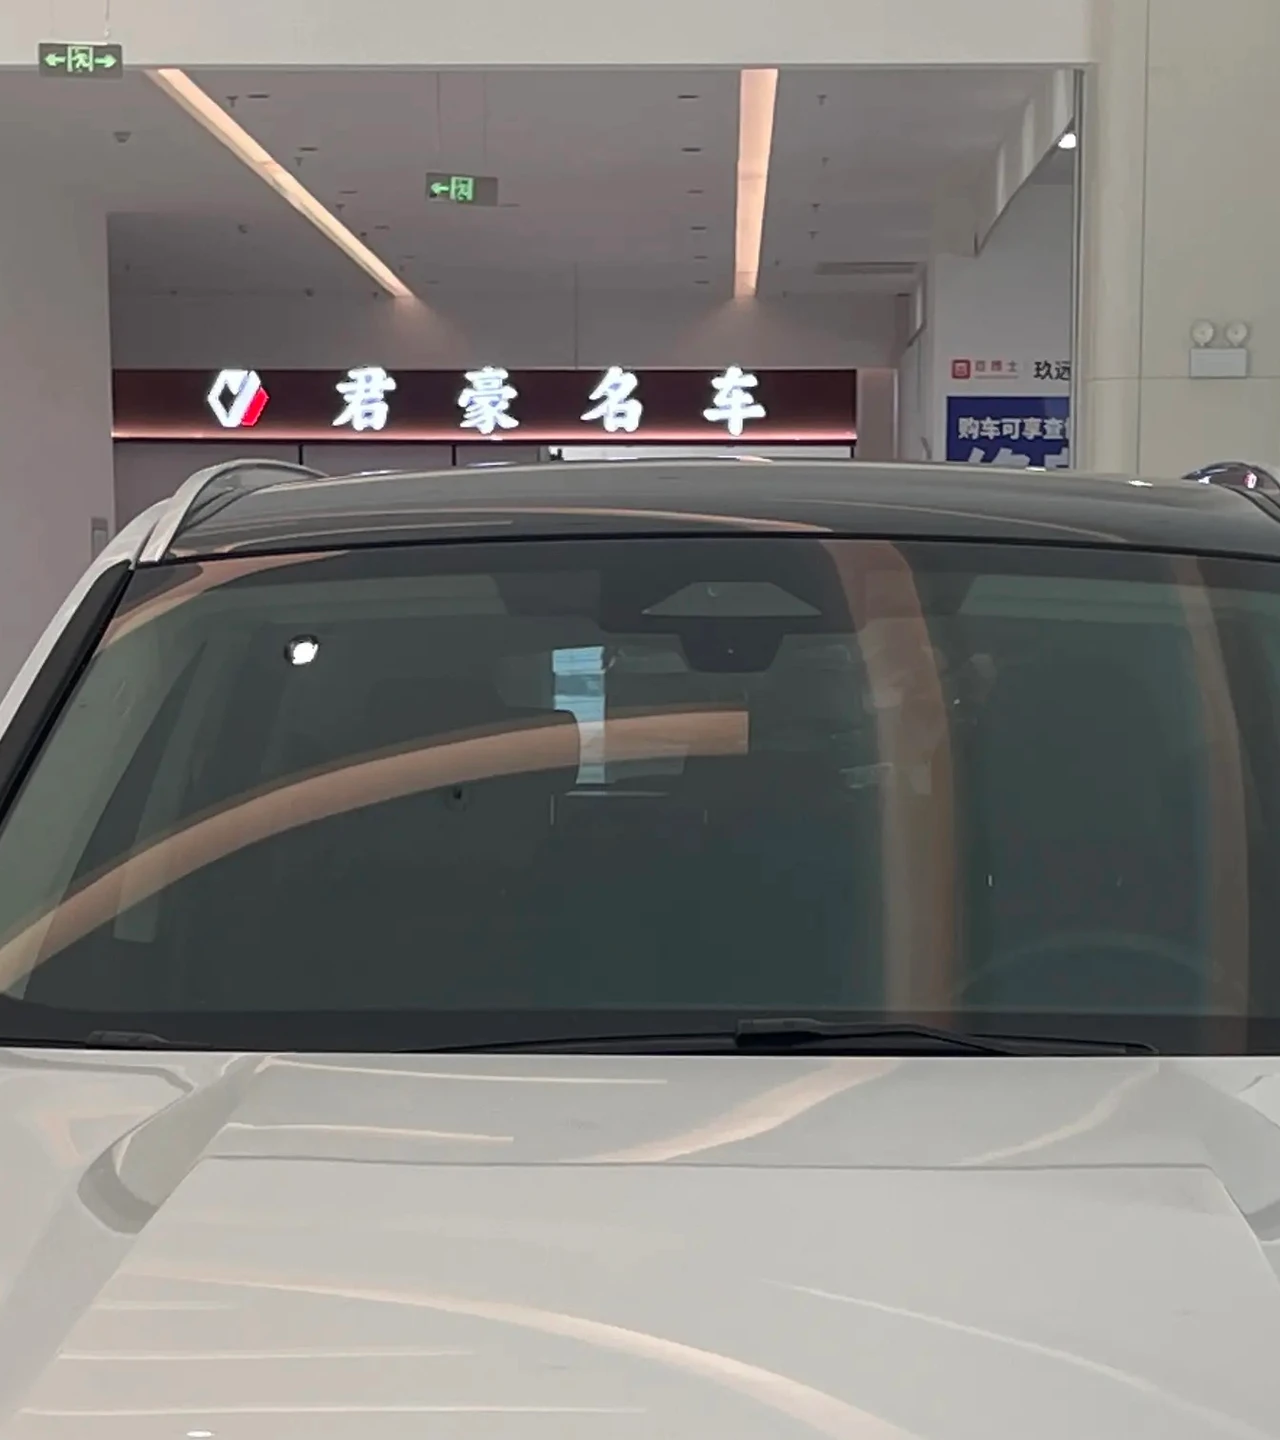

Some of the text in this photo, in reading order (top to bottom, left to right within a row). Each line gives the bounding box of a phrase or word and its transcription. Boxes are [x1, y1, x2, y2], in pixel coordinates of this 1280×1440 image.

[332, 365, 768, 436] 君豪名车
[958, 416, 1069, 440] 购车可享查
